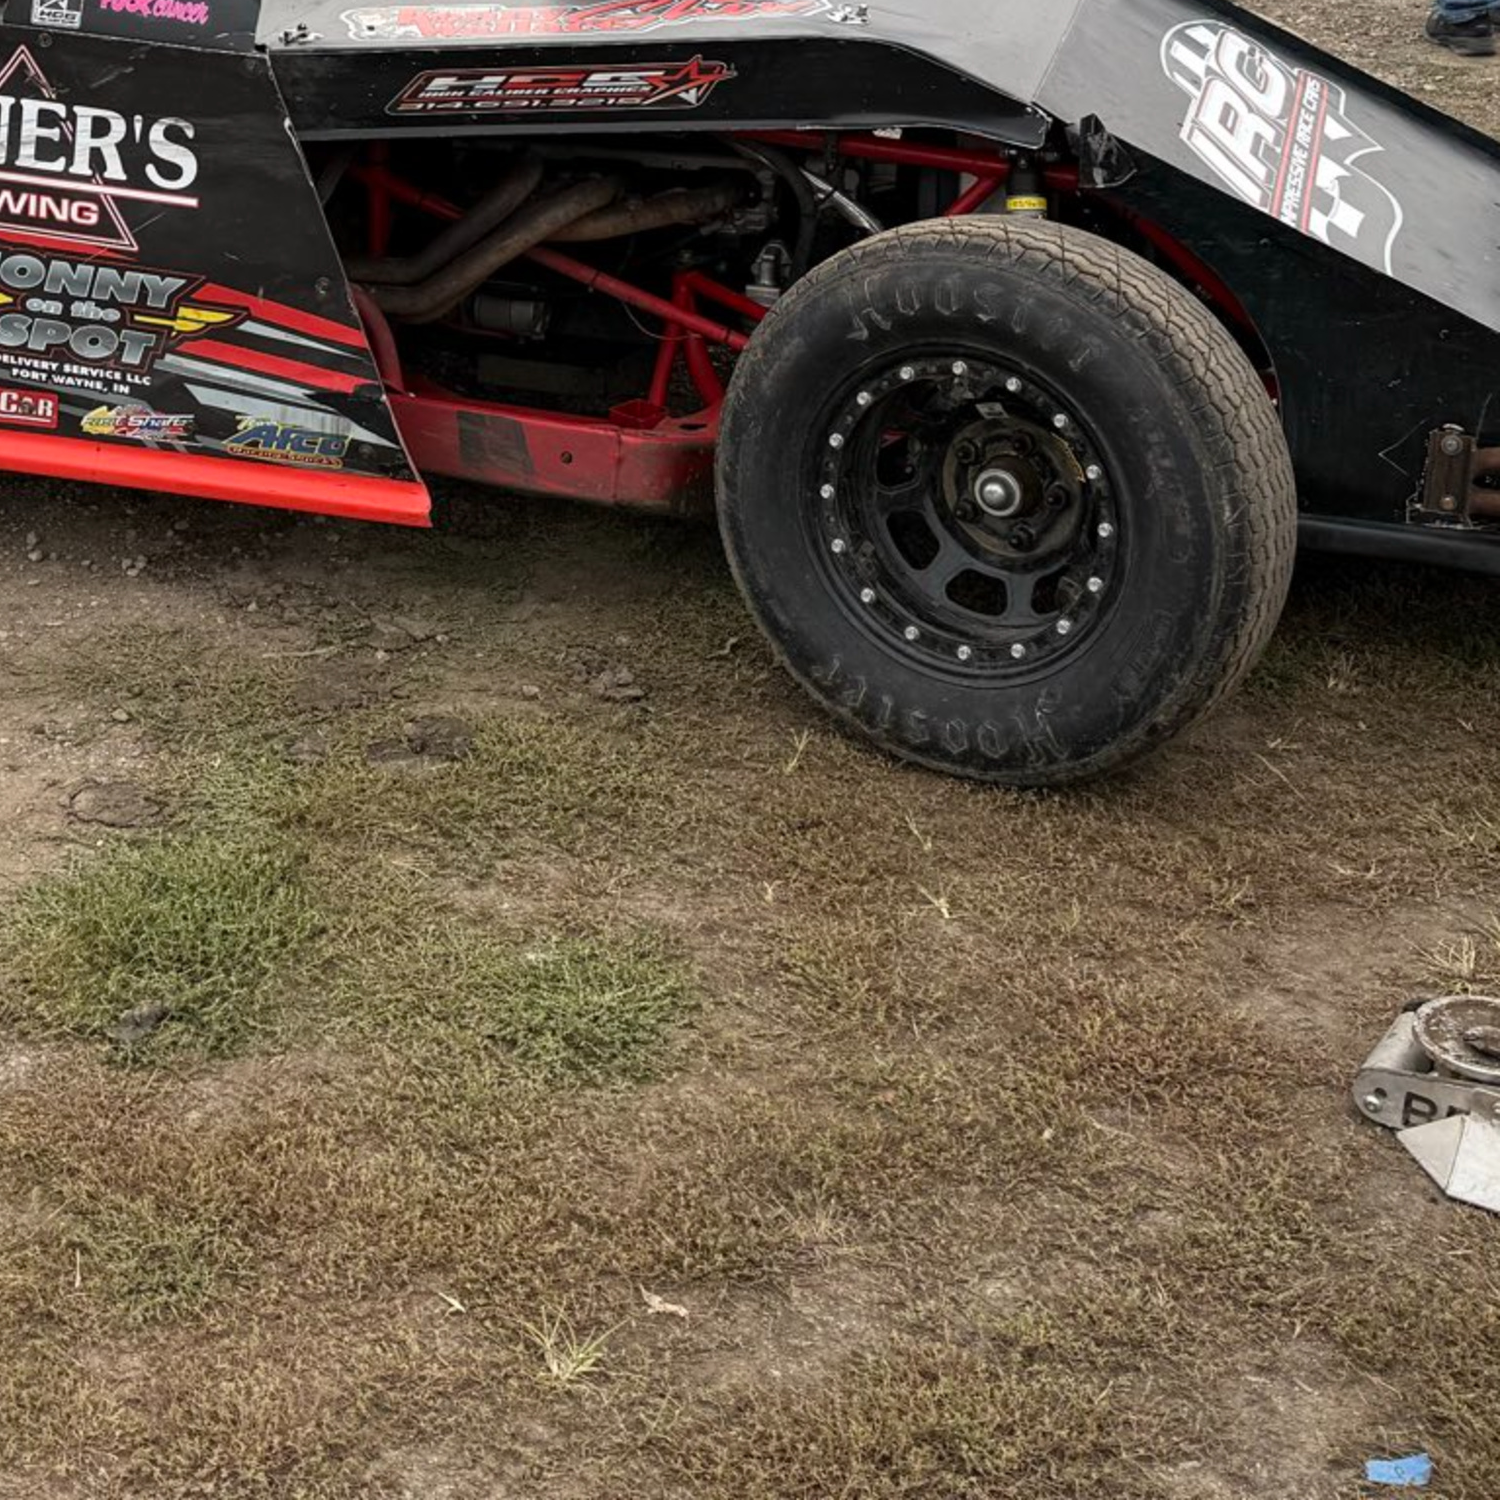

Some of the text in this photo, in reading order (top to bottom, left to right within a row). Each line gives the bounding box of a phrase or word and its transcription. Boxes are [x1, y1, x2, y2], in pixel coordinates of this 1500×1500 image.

[1279, 77, 1322, 227] MPRESSIVE RACE CARS
[26, 299, 121, 323] on the
[12, 368, 131, 395] FORT WAYNE, IN
[63, 363, 122, 382] SERVICE
[126, 373, 152, 386] LLC
[224, 425, 352, 456] AFCO
